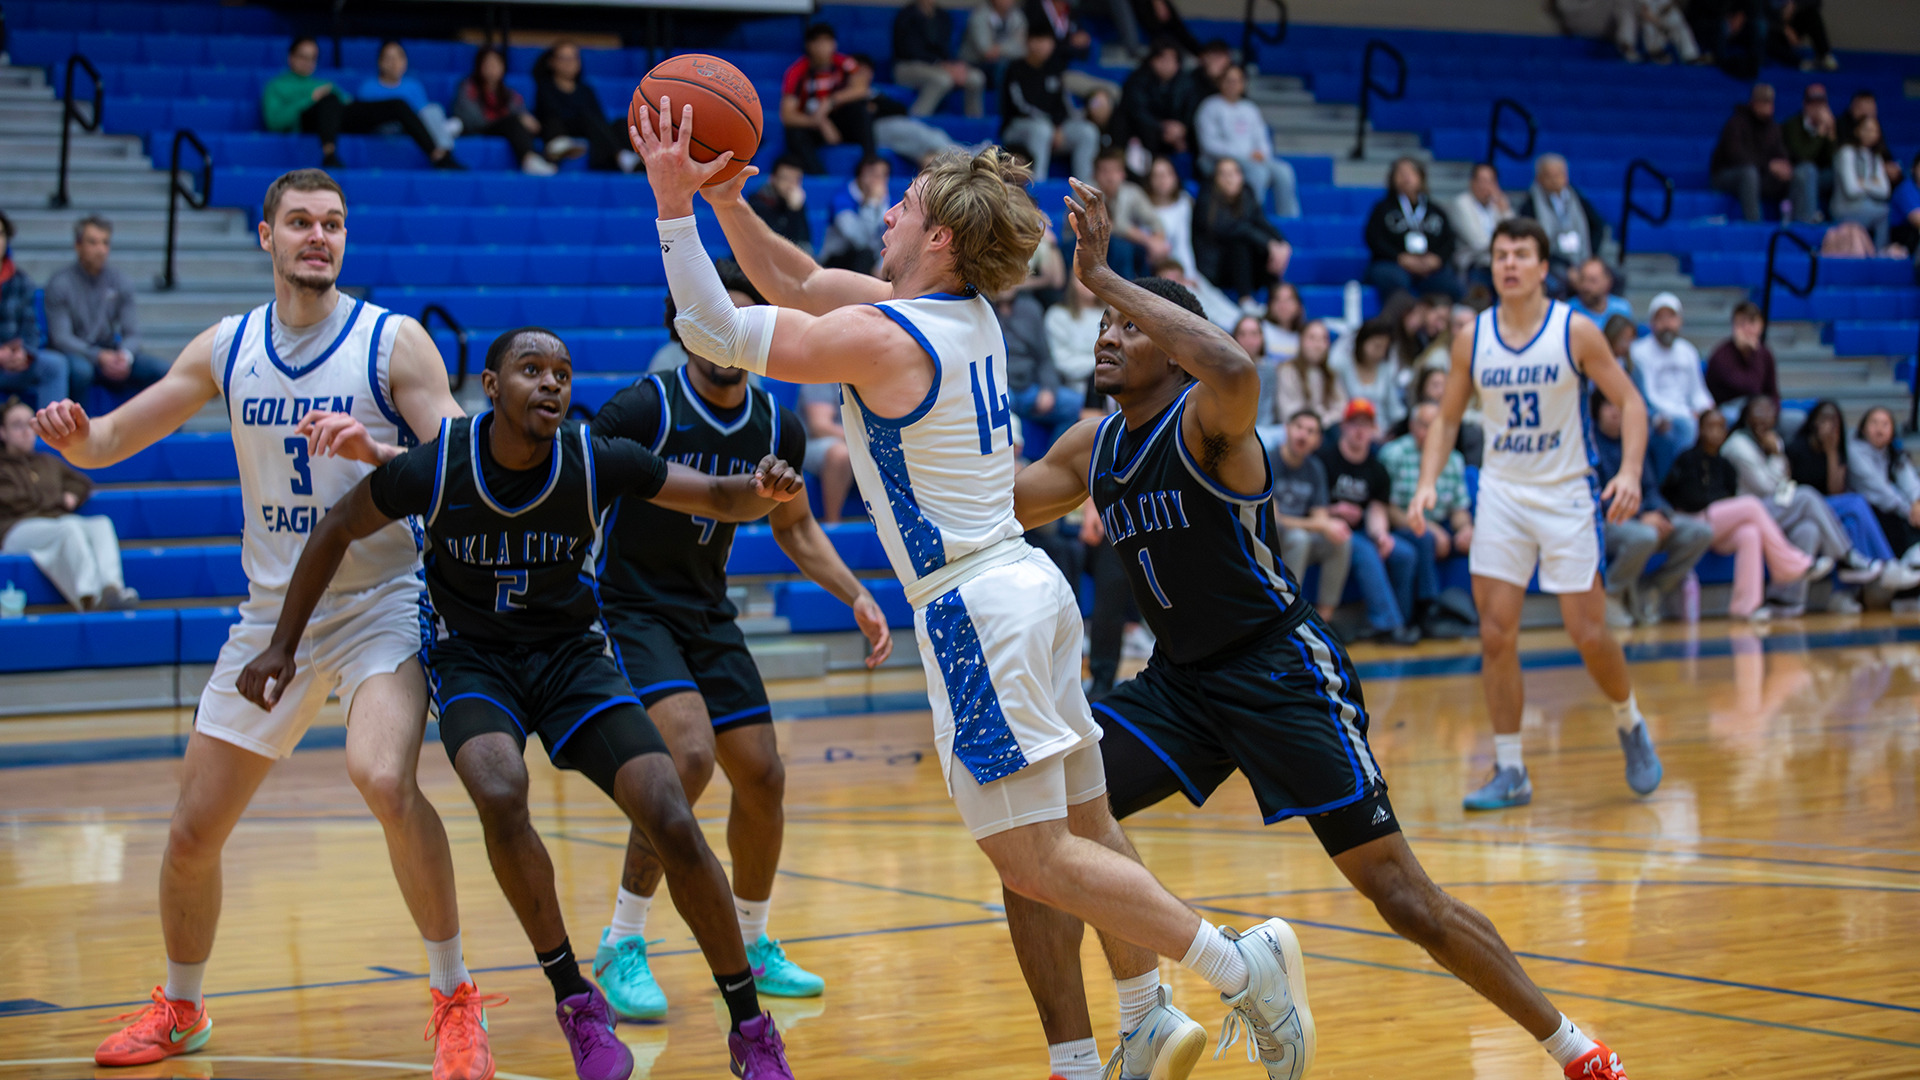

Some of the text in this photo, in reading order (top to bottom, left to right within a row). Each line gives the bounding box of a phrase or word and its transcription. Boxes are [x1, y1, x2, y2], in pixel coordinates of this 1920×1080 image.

[1481, 363, 1559, 387] GOLDEN
[969, 354, 1014, 455] 14
[1503, 391, 1541, 429] 33
[1493, 430, 1561, 453] EAGLES
[284, 437, 313, 496] 3
[1137, 489, 1190, 532] CITY
[523, 530, 579, 563] CITY
[494, 569, 529, 612] 2
[1137, 547, 1173, 609] 1
